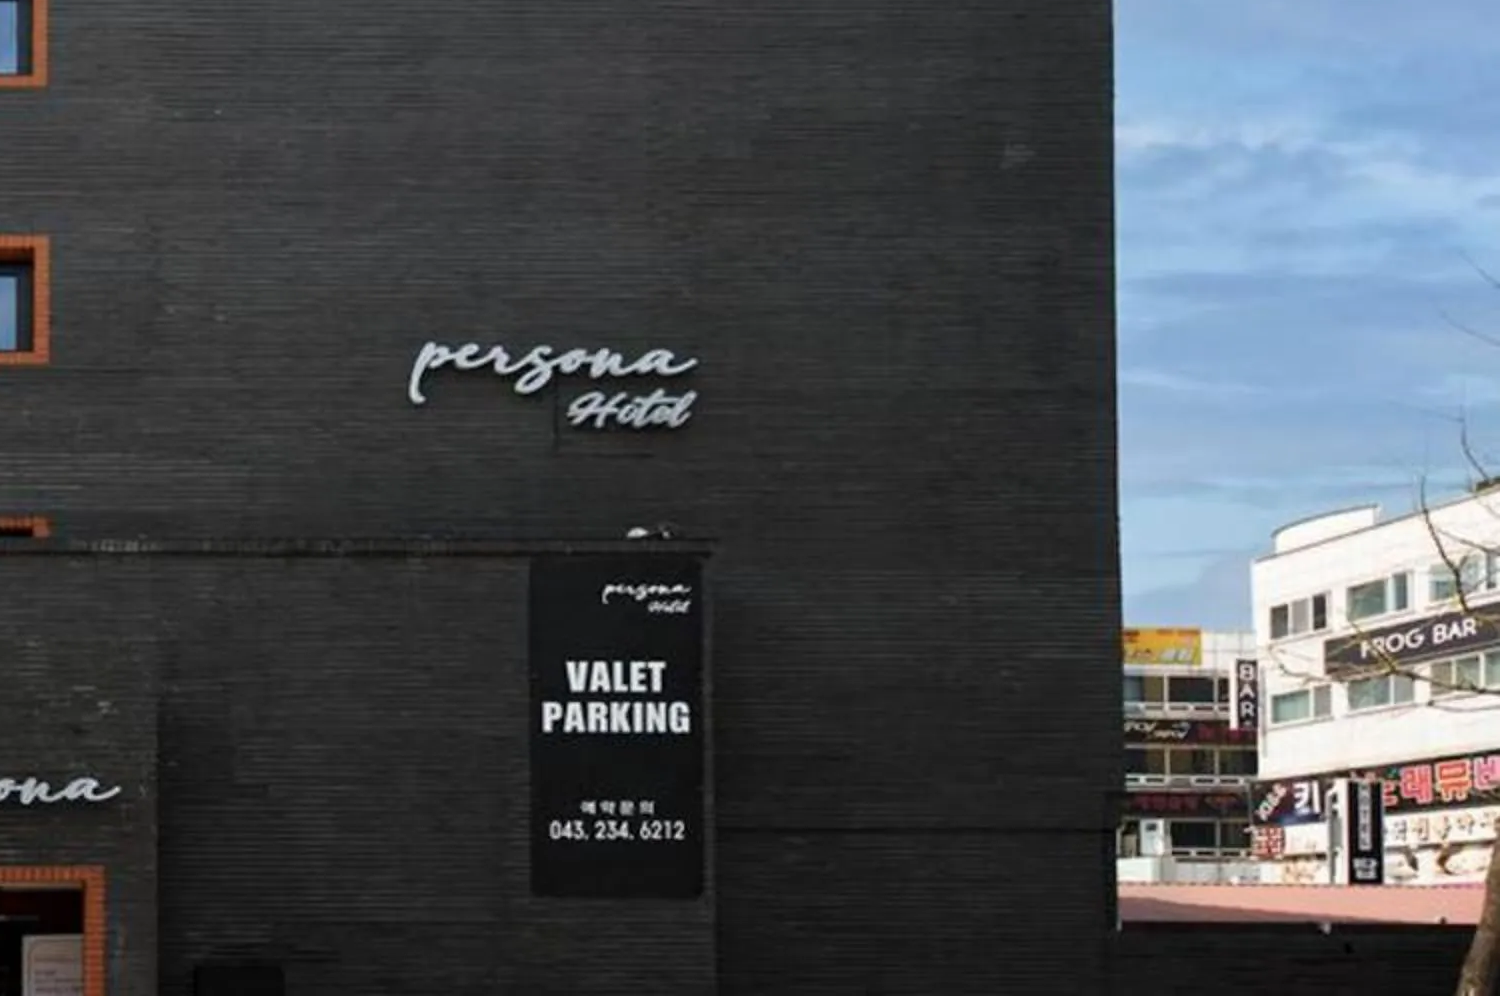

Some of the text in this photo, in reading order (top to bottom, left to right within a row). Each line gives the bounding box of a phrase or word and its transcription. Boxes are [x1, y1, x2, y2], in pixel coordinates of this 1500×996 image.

[408, 341, 698, 404] persona
[567, 387, 697, 428] Hotel
[602, 583, 692, 604] persona
[1360, 617, 1477, 660] FROG BAR
[565, 660, 666, 693] VALET
[1239, 662, 1256, 720] BAR
[542, 701, 690, 734] PARKING
[639, 819, 685, 841] 6212
